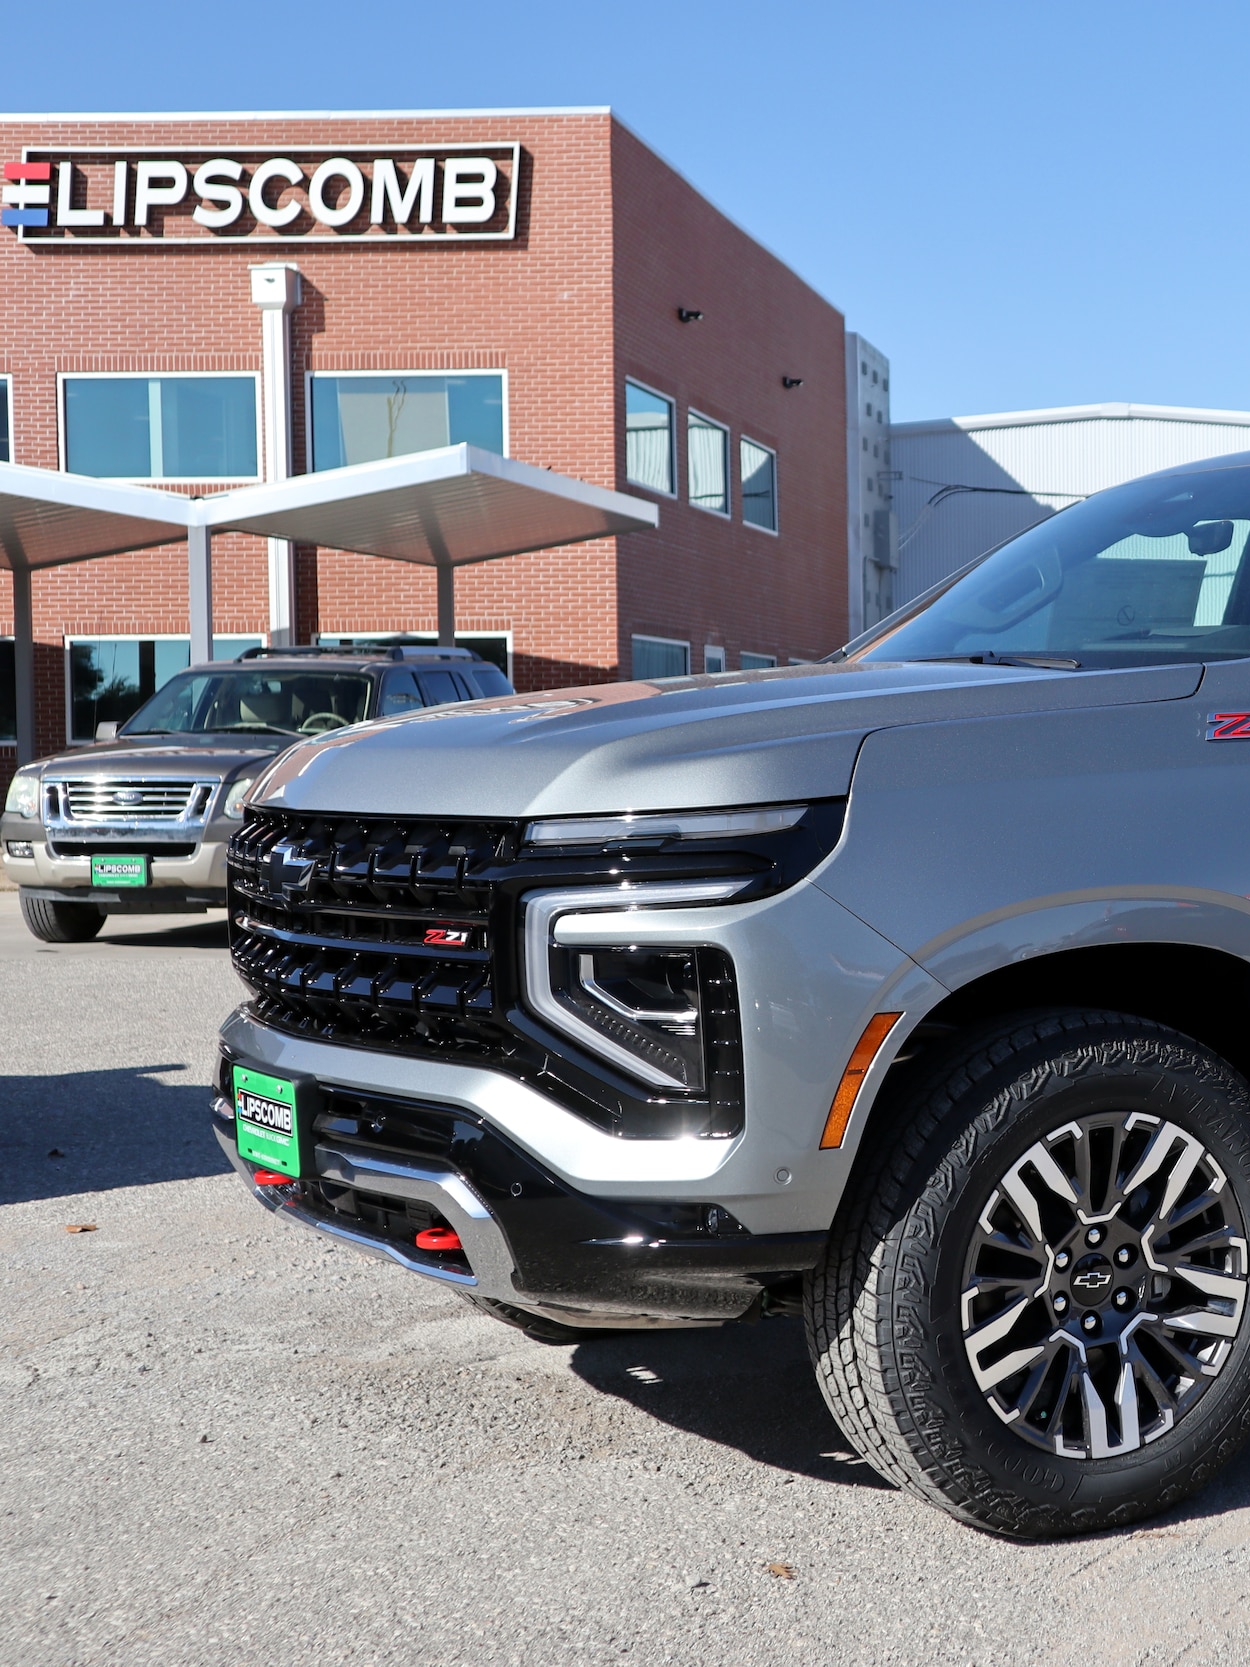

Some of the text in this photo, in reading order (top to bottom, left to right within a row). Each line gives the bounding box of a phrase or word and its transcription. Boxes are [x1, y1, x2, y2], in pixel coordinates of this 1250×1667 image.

[57, 157, 498, 228] LIPSCOMB
[423, 928, 468, 946] Z71
[242, 1093, 291, 1130] LIPSCOMB
